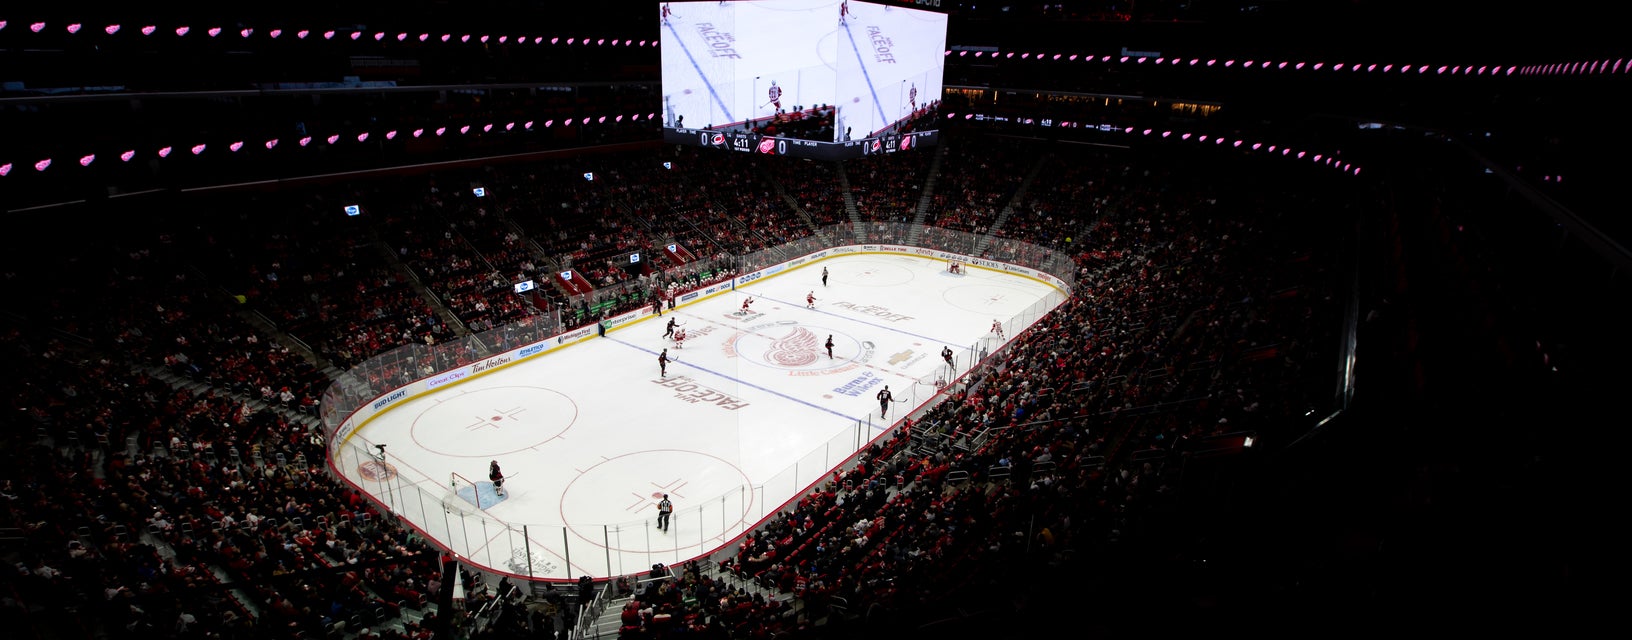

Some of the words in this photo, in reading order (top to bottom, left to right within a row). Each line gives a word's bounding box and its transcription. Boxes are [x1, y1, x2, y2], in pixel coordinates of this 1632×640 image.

[701, 132, 708, 146] 0
[733, 138, 749, 148] 4:11
[885, 139, 896, 149] 4:11
[911, 135, 917, 148] 0
[778, 140, 786, 155] 0
[863, 141, 869, 155] 0
[563, 331, 581, 340] Michigan
[581, 328, 591, 336] First
[471, 363, 485, 374] Tim
[485, 357, 511, 369] Hortons
[429, 377, 448, 386] Great
[449, 371, 465, 380] Clips
[832, 376, 868, 394] Burns
[651, 377, 750, 411] FACE-OFF
[845, 377, 884, 397] Wilcox
[374, 399, 387, 410] BUD
[387, 390, 406, 402] LIGHT
